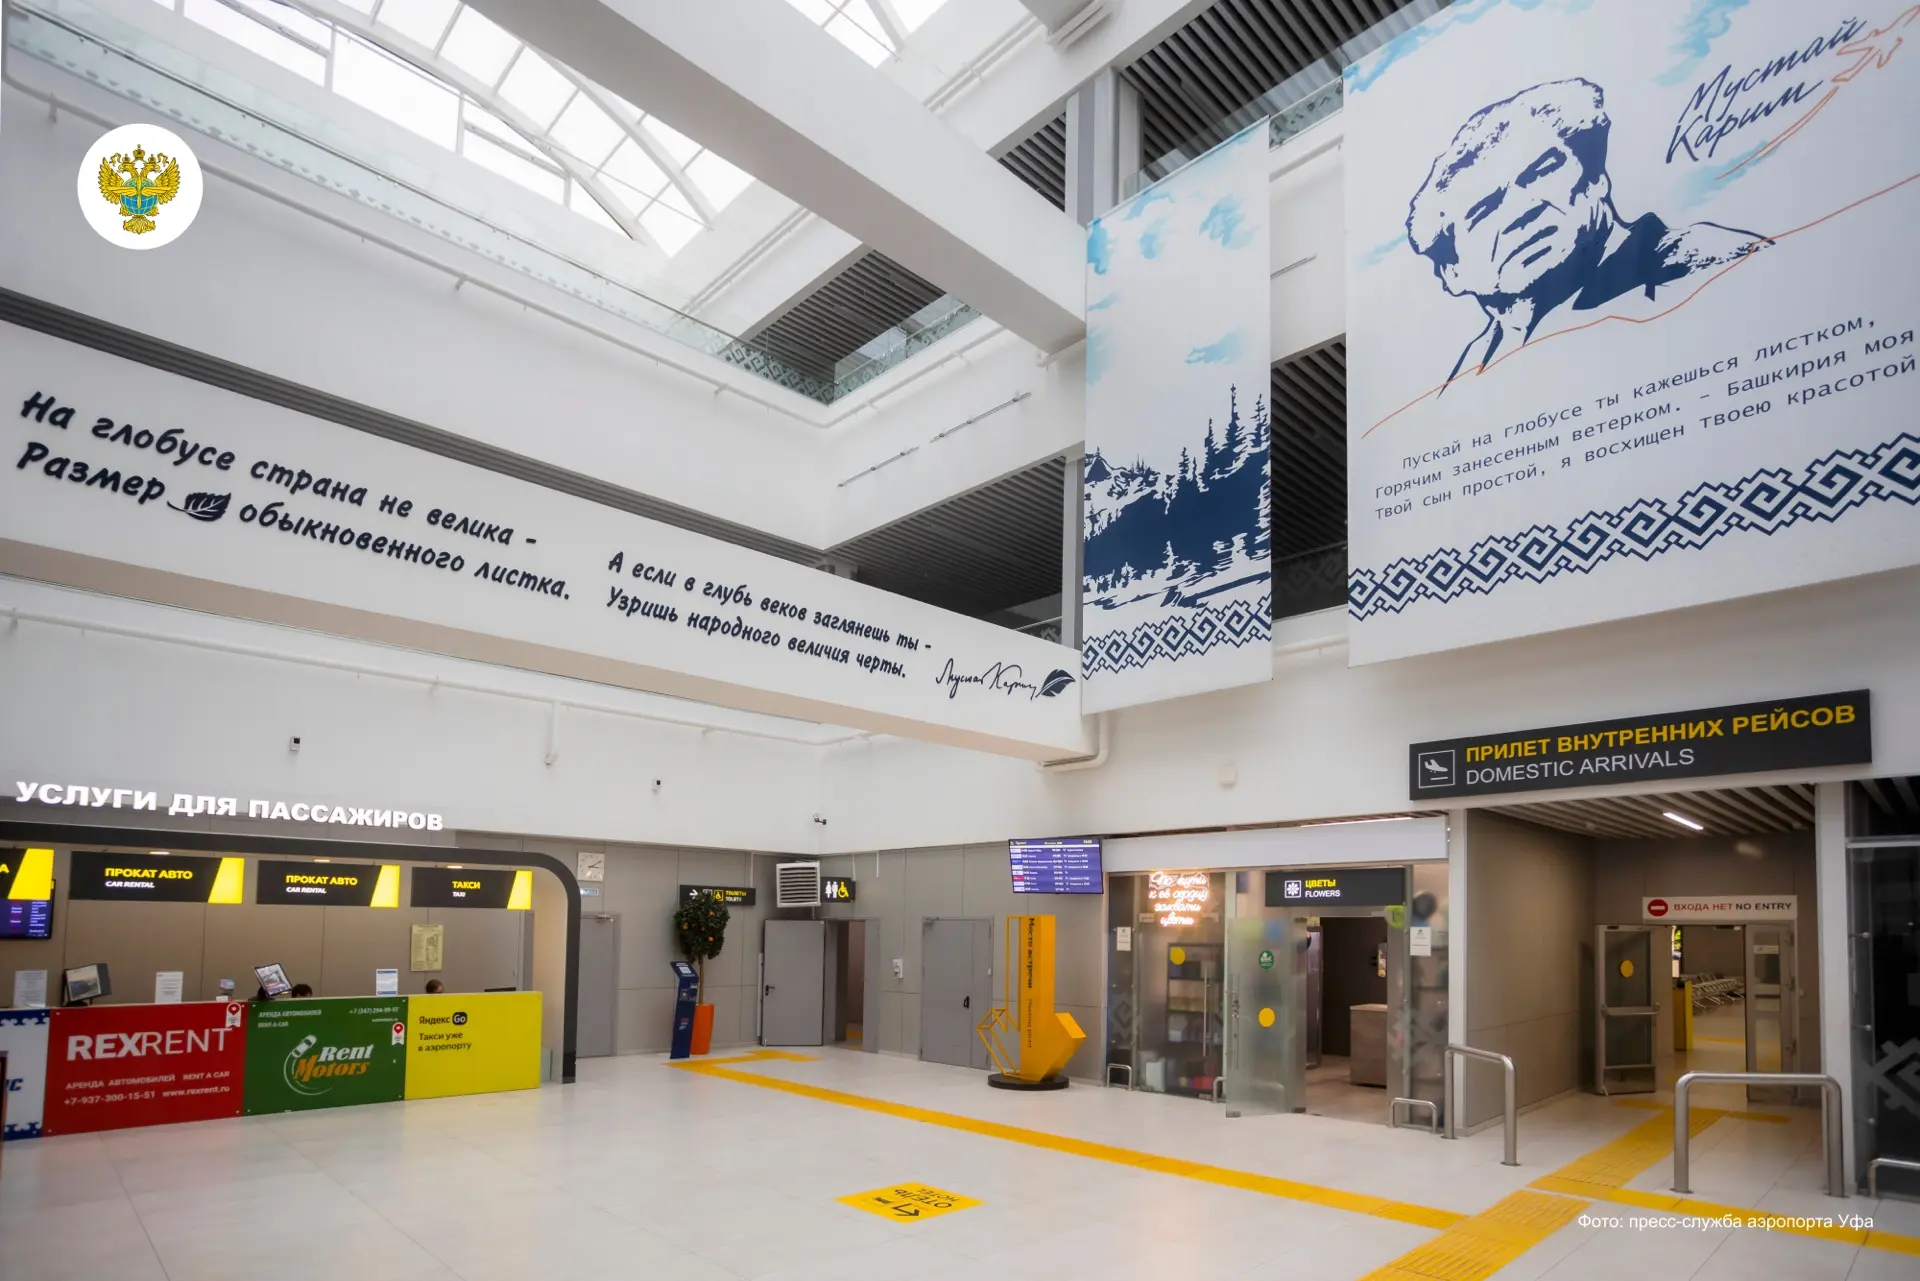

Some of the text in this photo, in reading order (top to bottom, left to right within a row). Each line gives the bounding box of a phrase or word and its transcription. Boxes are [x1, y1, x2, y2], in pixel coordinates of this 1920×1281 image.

[1678, 16, 1867, 122] Мустай
[1666, 80, 1824, 164] Карим
[1472, 433, 1493, 448] на
[1504, 405, 1582, 438] глобусе
[1595, 394, 1619, 410] ты
[1634, 357, 1738, 398] кажешься
[1755, 317, 1875, 361] листком,
[1452, 435, 1560, 477] занесенным
[1572, 403, 1681, 441] ветерком.
[1727, 350, 1846, 396] Башкирия
[1865, 330, 1914, 355] моя
[1423, 490, 1452, 506] сын
[1462, 463, 1546, 496] простой,
[1561, 457, 1571, 468] я
[1585, 425, 1684, 462] восхищен
[1699, 400, 1771, 429] твоею
[1787, 354, 1916, 404] красотой
[20, 390, 75, 430] На
[91, 416, 236, 471] глобусе
[250, 458, 367, 508] страна
[379, 494, 413, 519] не
[426, 508, 514, 546] велика
[16, 441, 570, 602] Размер обыкновенного листка.
[608, 551, 624, 573] А
[632, 561, 676, 588] если
[684, 573, 695, 592] в
[703, 581, 753, 608] глубь
[761, 594, 807, 622] веков
[813, 611, 891, 644] заглянешь
[896, 632, 919, 652] ты
[606, 586, 906, 679] Узришь народного величия черты.
[1466, 705, 1856, 762] ПРИЛЕТ ВНУТРЕННИХ РЕЙСОВ
[1466, 748, 1695, 785] DOMESTIC ARRIVALS
[16, 780, 444, 831] УСЛУГИ ДЛЯ ПАССАЖИРОВ
[104, 867, 193, 880] ПРОКАТ АВТО
[105, 880, 155, 889] CAR RENTAL
[285, 874, 358, 886] ПРОКАТ АВТО
[452, 880, 481, 889] ТАКСИ
[1305, 879, 1336, 888] ЦВЕТЫ
[1673, 903, 1709, 911] ВХОДА
[1713, 903, 1733, 911] НЕТ
[1755, 902, 1792, 910] ENTRY
[419, 1013, 467, 1025] Яндекс Go
[67, 1027, 233, 1061] REXRENT
[317, 1044, 374, 1062] Rent
[419, 1032, 464, 1041] Такси уже
[425, 1042, 472, 1051] аэропорту
[65, 1080, 105, 1090] АРЕНДА
[108, 1074, 176, 1087] АВТОМОБИЛЕЙ
[182, 1072, 204, 1081] RENT
[213, 1071, 230, 1079] CAR
[294, 1054, 370, 1082] Motors
